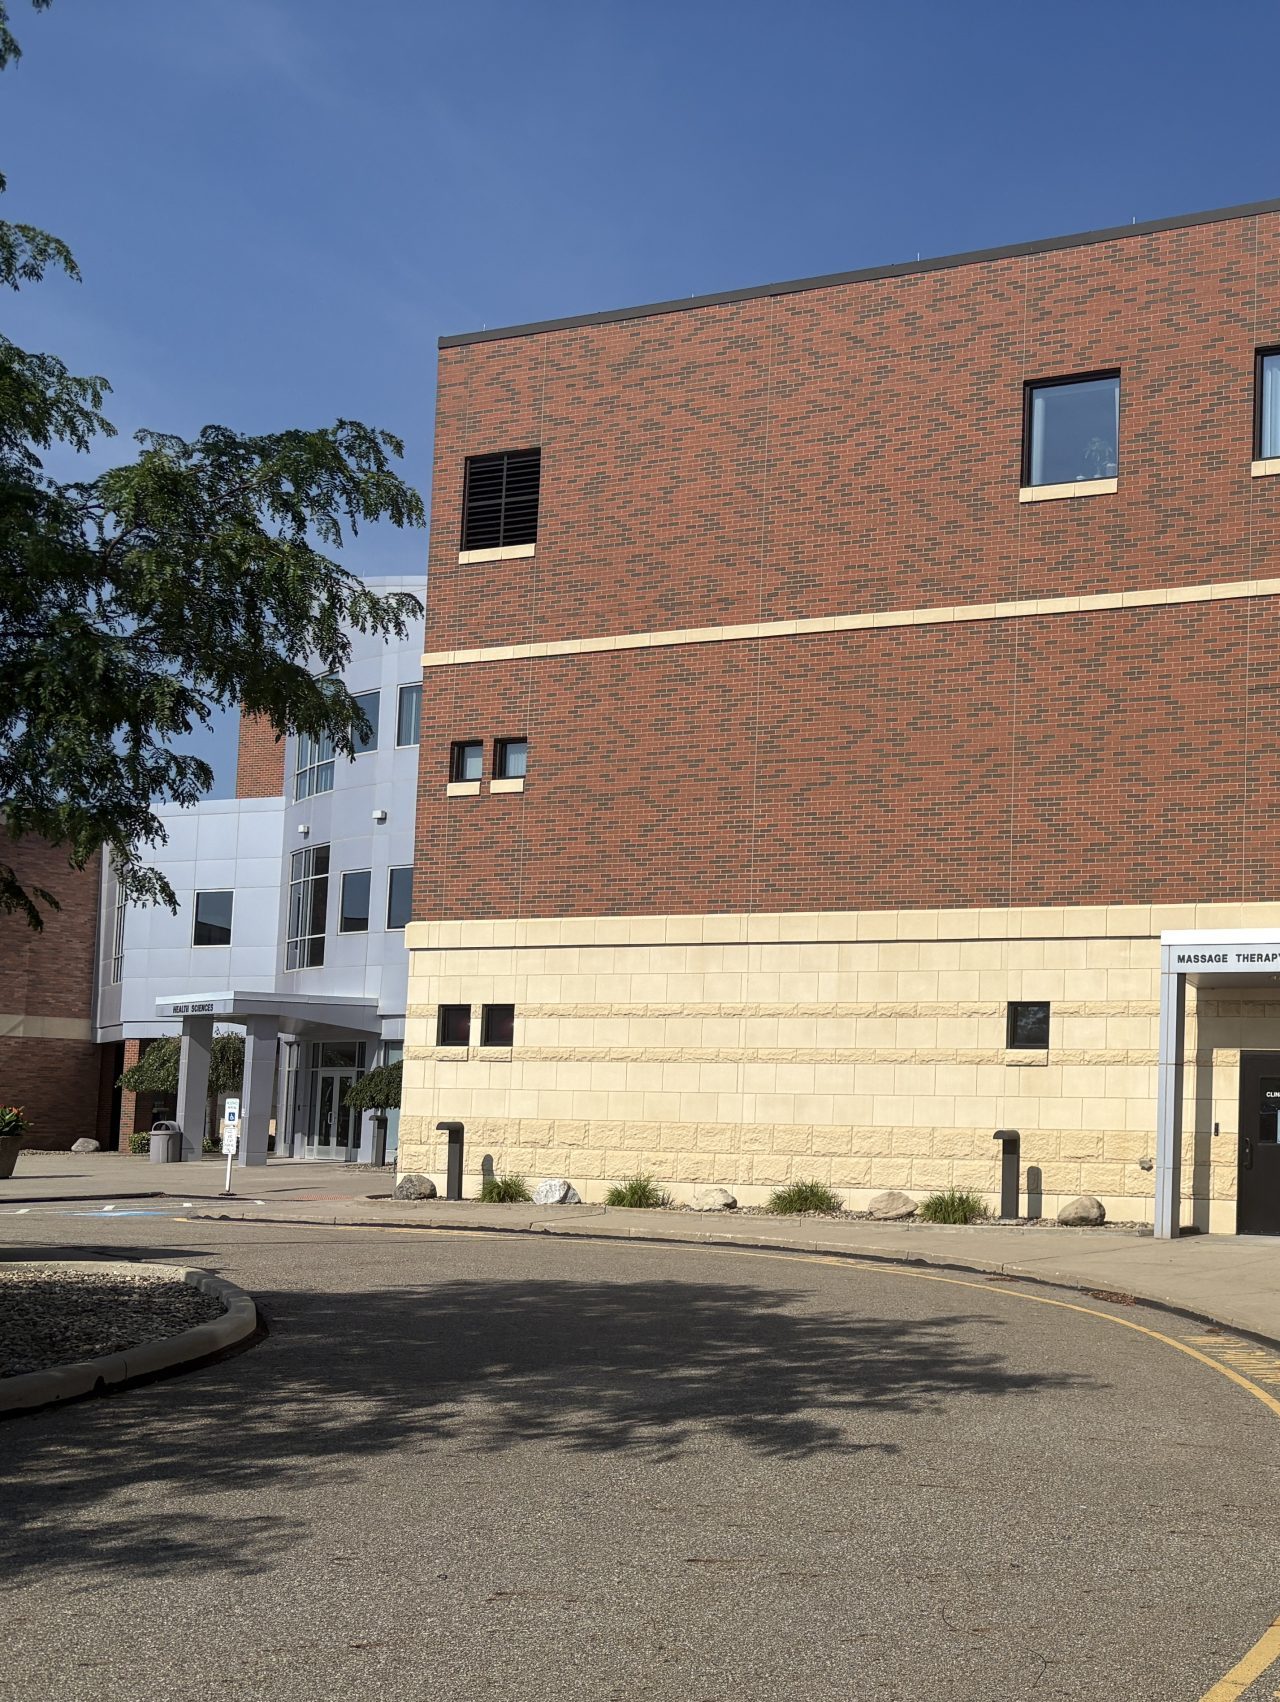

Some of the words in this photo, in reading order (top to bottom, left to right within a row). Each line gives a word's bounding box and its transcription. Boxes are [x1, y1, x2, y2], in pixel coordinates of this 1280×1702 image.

[1177, 953, 1229, 964] MASSAGE
[172, 1004, 190, 1014] HEALTH
[191, 1003, 214, 1013] SCIENCES
